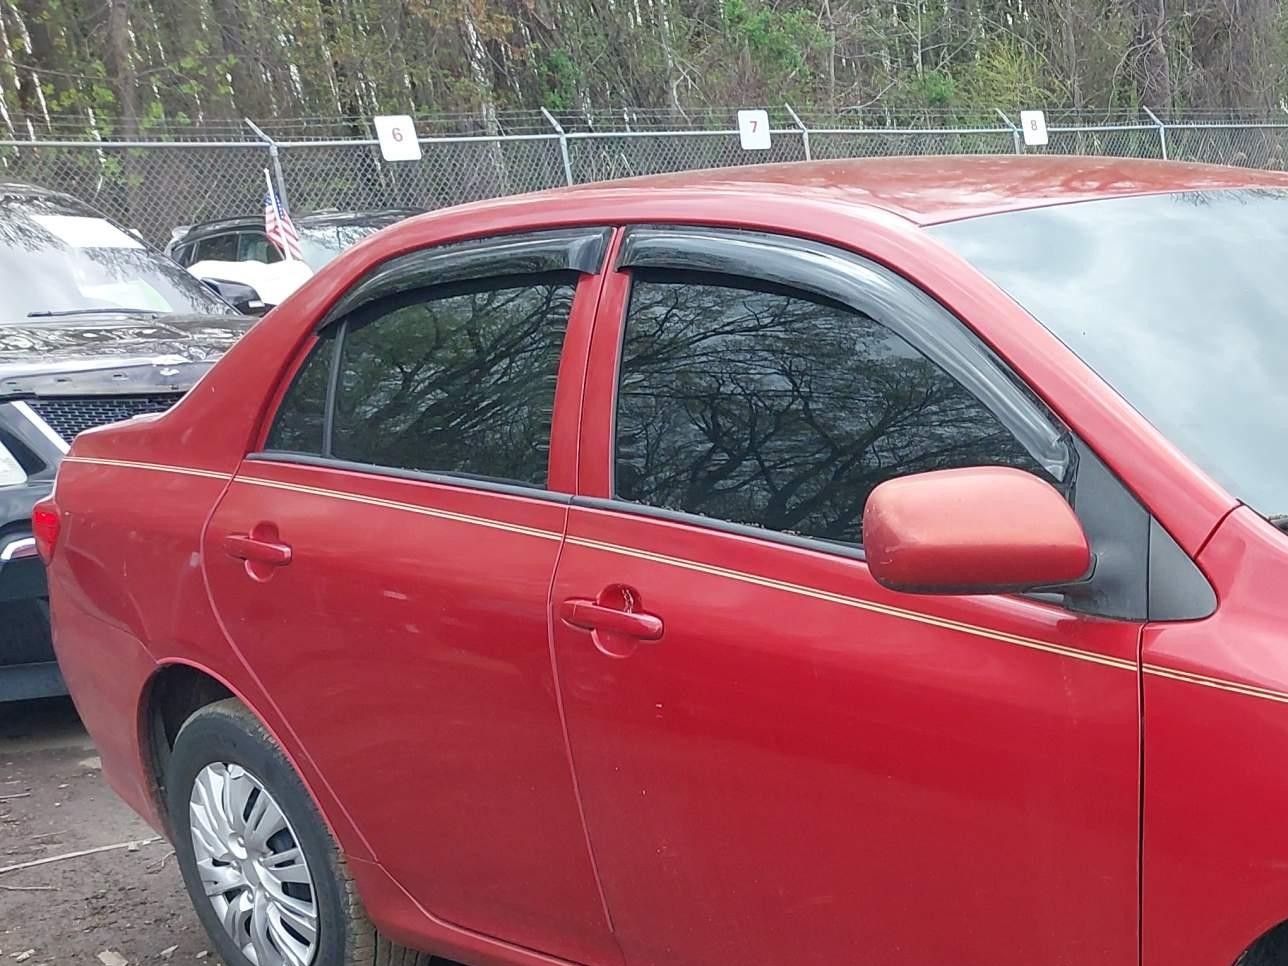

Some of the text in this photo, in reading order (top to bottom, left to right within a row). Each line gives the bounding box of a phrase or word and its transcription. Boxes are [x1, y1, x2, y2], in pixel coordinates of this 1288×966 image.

[749, 120, 757, 133] 7
[1030, 119, 1038, 131] 8
[391, 127, 404, 142] 6
